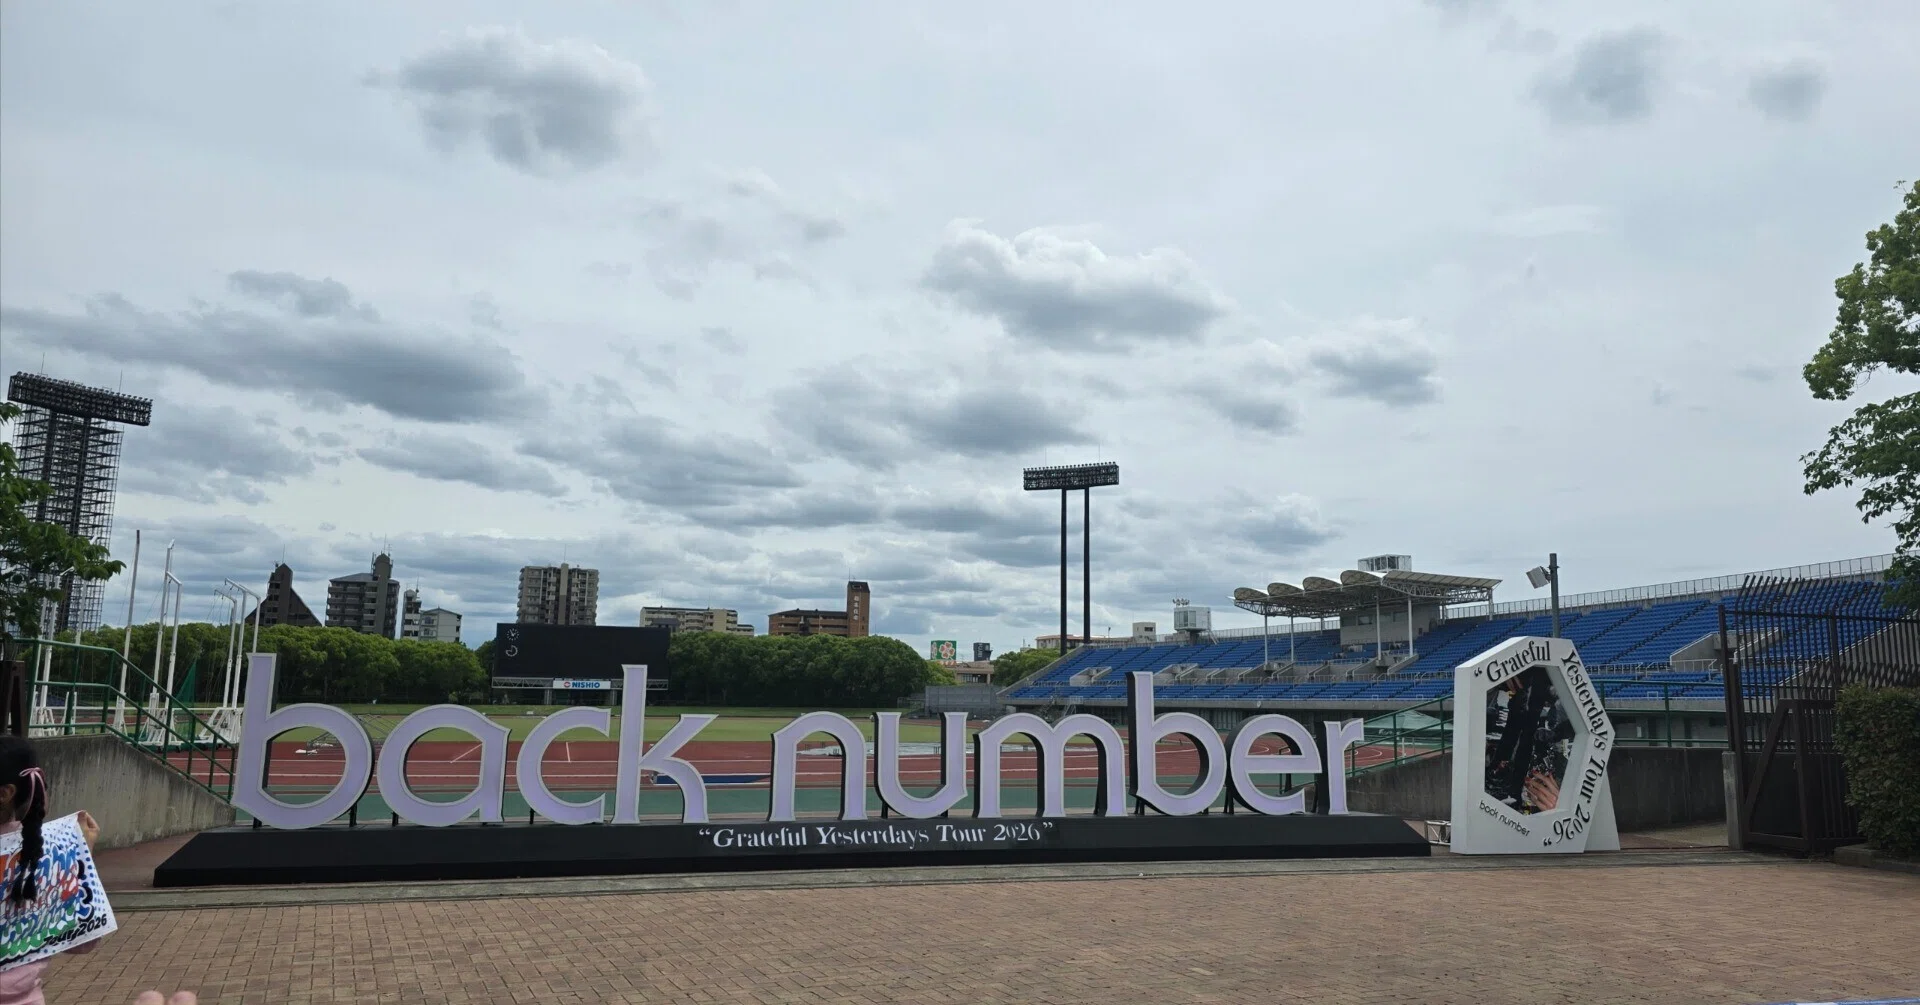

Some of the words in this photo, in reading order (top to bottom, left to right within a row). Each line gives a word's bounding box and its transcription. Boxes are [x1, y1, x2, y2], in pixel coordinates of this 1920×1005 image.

[1561, 650, 1609, 751] Yesterdays
[230, 652, 719, 830] back
[767, 671, 1365, 821] number
[1579, 754, 1606, 804] Tour
[816, 824, 930, 849] Yesterdays
[936, 823, 986, 843] Tour
[1479, 800, 1499, 818] back
[1498, 814, 1531, 837] number
